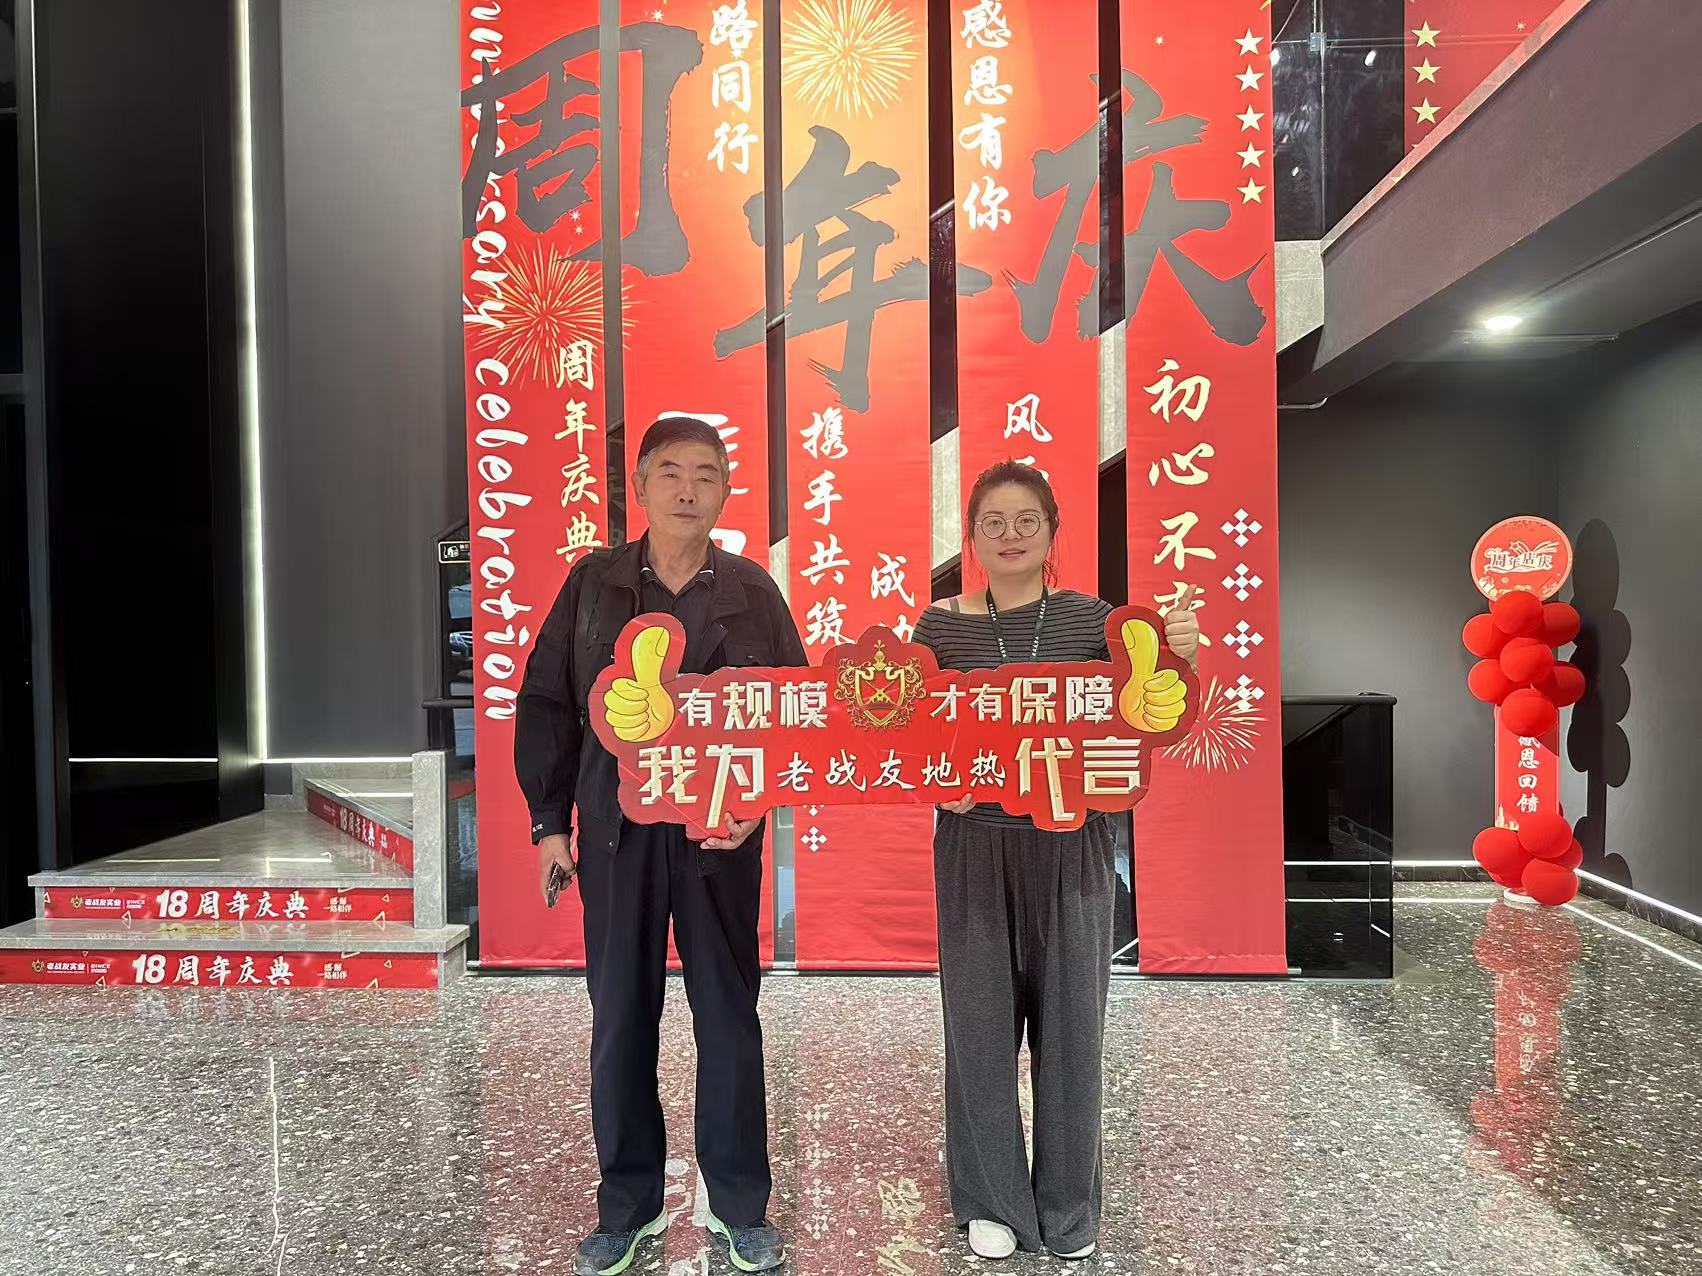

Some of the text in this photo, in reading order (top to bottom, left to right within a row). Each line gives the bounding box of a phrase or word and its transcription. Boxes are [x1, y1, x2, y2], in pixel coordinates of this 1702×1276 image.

[707, 0, 758, 174] 路同行
[959, 0, 1013, 231] 感恩有你
[462, 20, 1268, 413] 周年庆
[474, 358, 533, 720] celebration
[555, 340, 602, 562] 周年庆典
[799, 406, 856, 646] 携手共筑
[637, 734, 1142, 829] 我为老战友地热代言
[678, 675, 1114, 730] 有规模 才有保障
[132, 953, 294, 986] 18周年庆典
[155, 889, 309, 921] 18周年庆典
